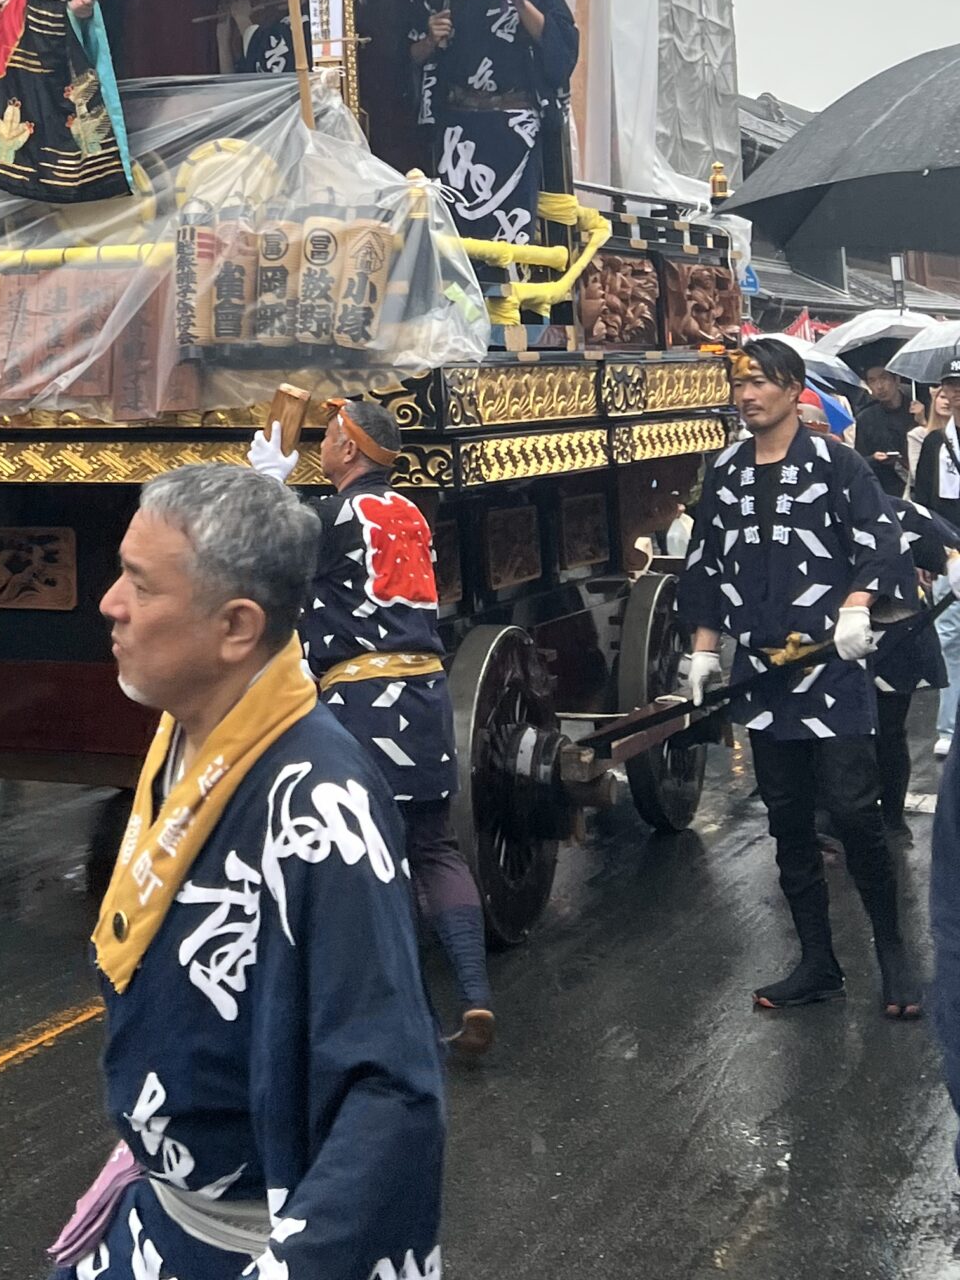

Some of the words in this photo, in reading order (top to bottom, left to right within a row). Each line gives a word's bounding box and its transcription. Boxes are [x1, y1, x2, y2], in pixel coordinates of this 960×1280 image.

[336, 271, 377, 343] 小塚
[772, 465, 800, 545] 連雀町
